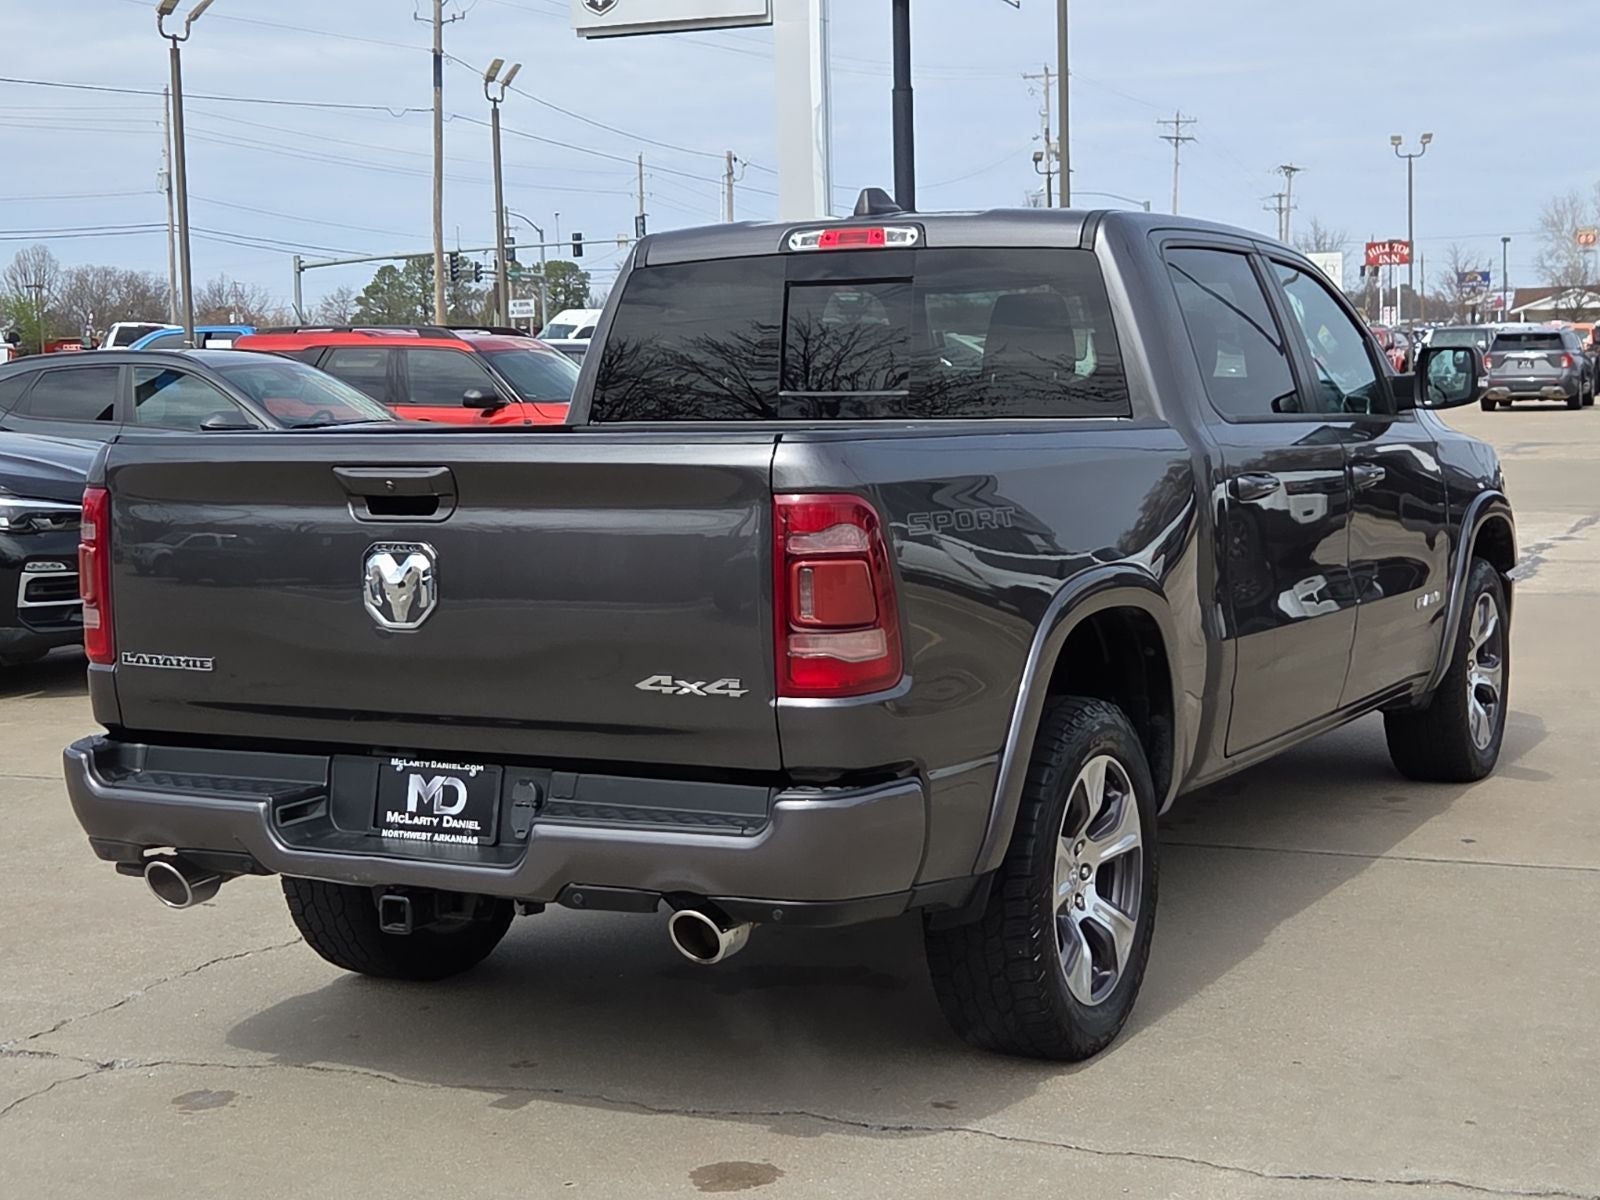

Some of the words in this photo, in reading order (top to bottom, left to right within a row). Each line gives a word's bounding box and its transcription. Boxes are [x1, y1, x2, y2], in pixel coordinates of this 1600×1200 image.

[1378, 254, 1400, 264] INN
[907, 506, 1015, 536] SPORT
[121, 652, 215, 671] LARAMIE
[407, 773, 468, 816] MD
[442, 815, 481, 830] DANIEL
[381, 829, 432, 841] NORTHWEST
[433, 833, 479, 845] ARKANSAS
